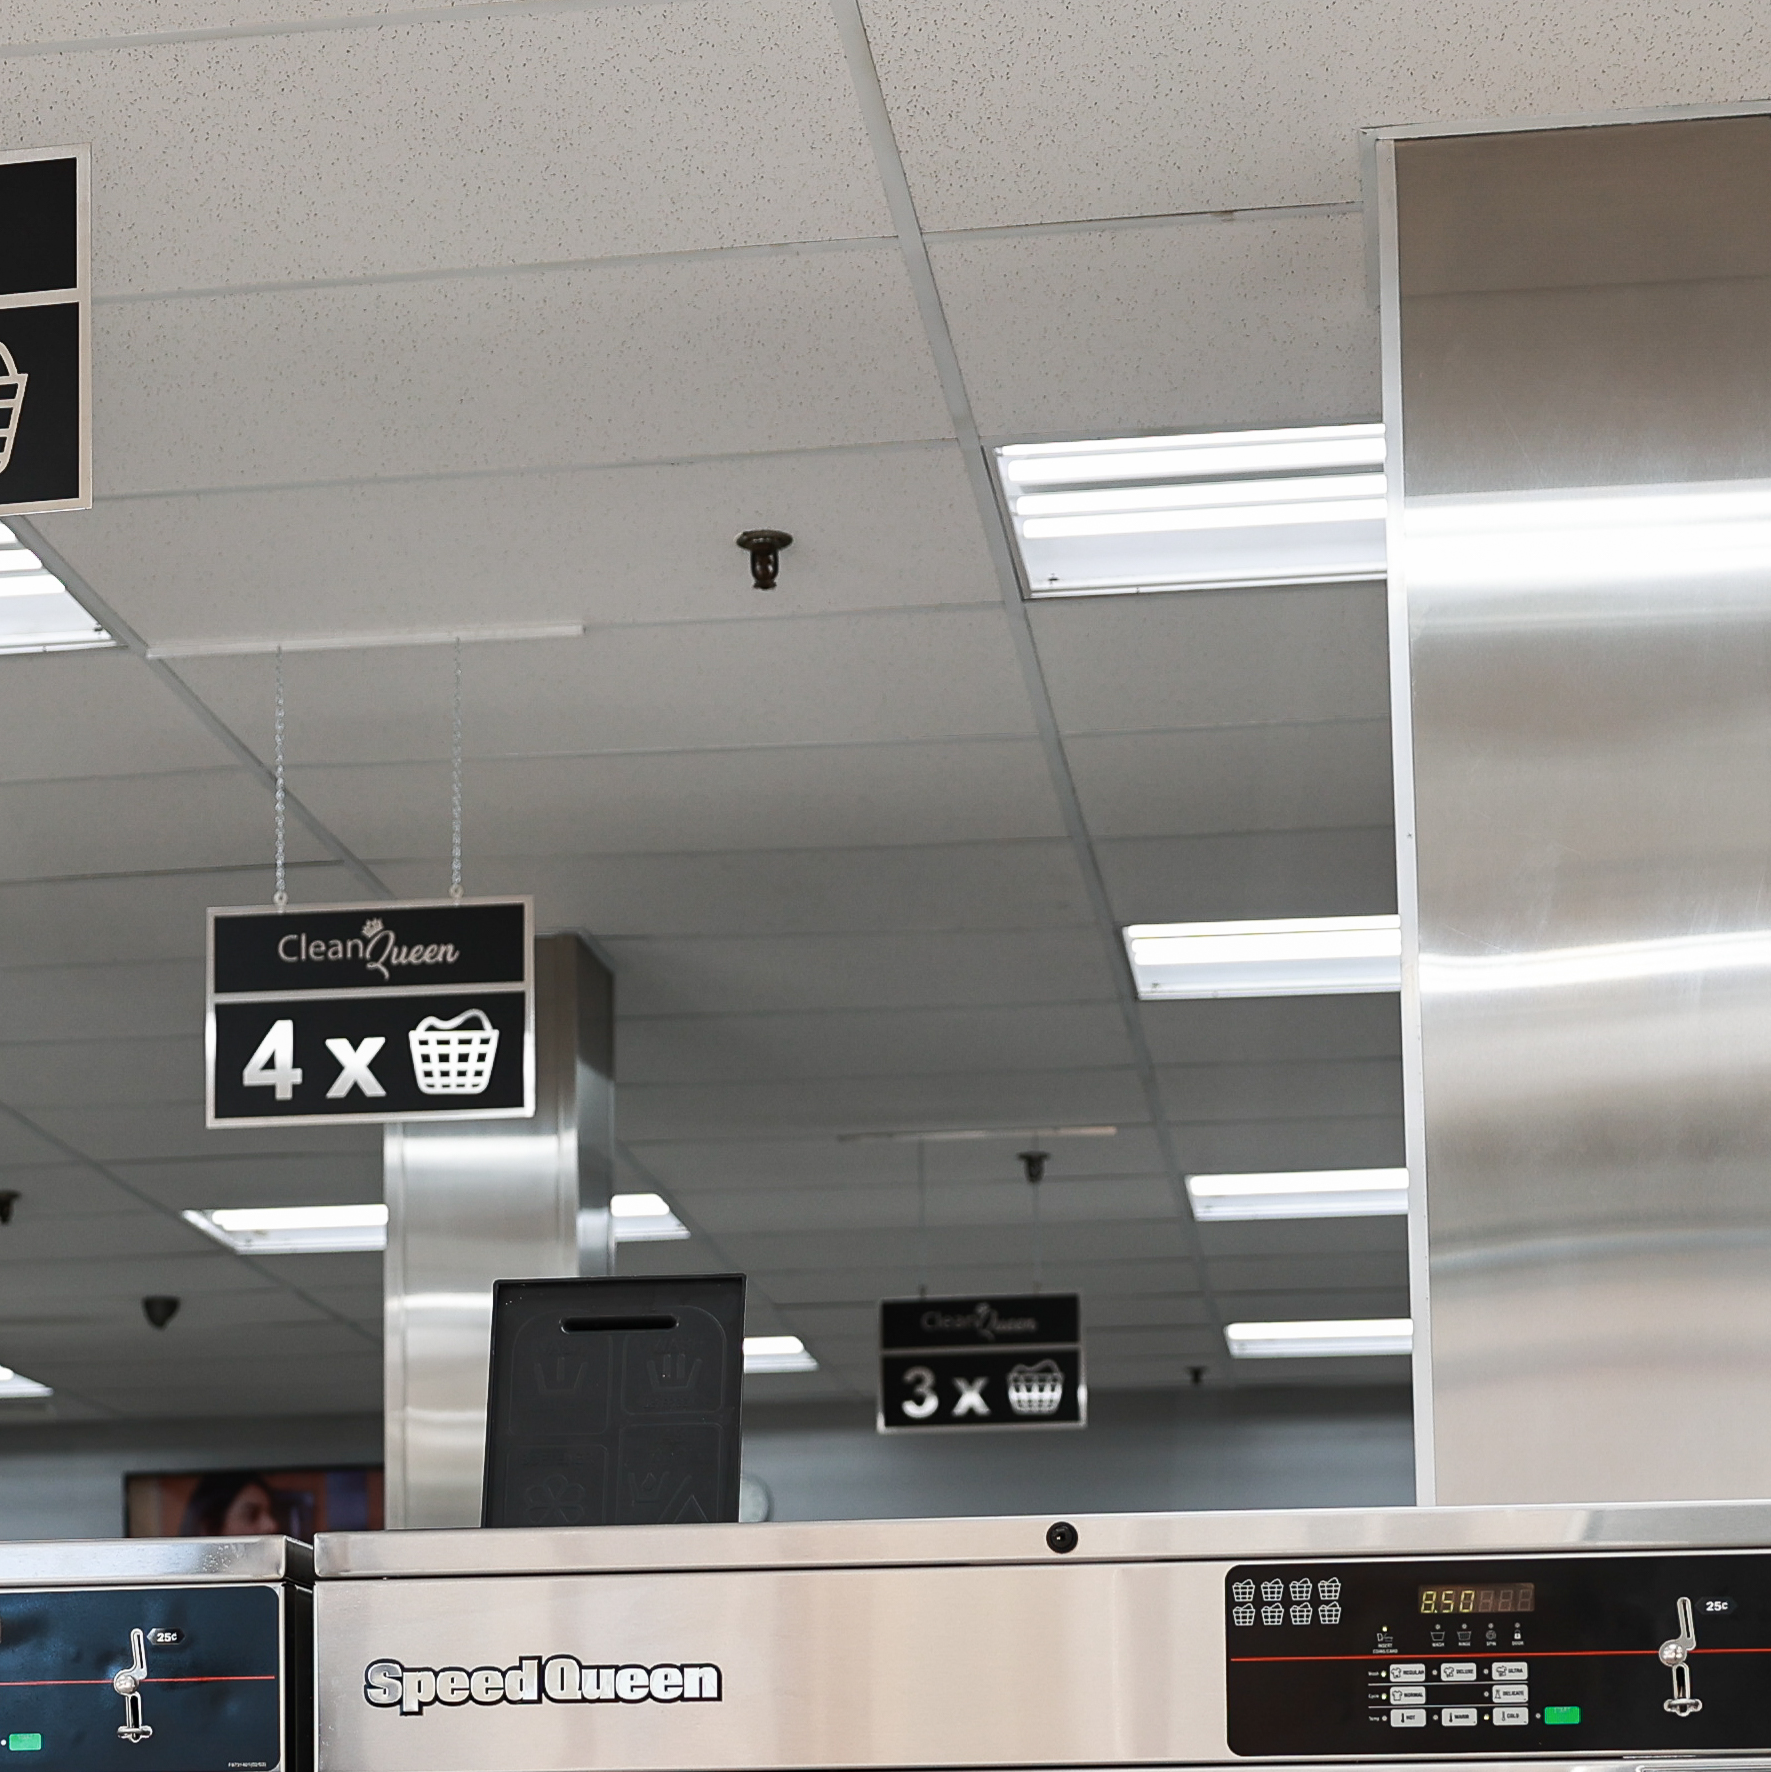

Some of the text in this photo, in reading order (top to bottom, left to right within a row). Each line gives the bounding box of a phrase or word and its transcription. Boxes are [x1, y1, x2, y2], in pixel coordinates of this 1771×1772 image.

[242, 1019, 386, 1100] 4 x
[901, 1365, 991, 1419] 3 x
[156, 1632, 178, 1642] 25¢
[364, 1653, 722, 1716] Speed Queen
